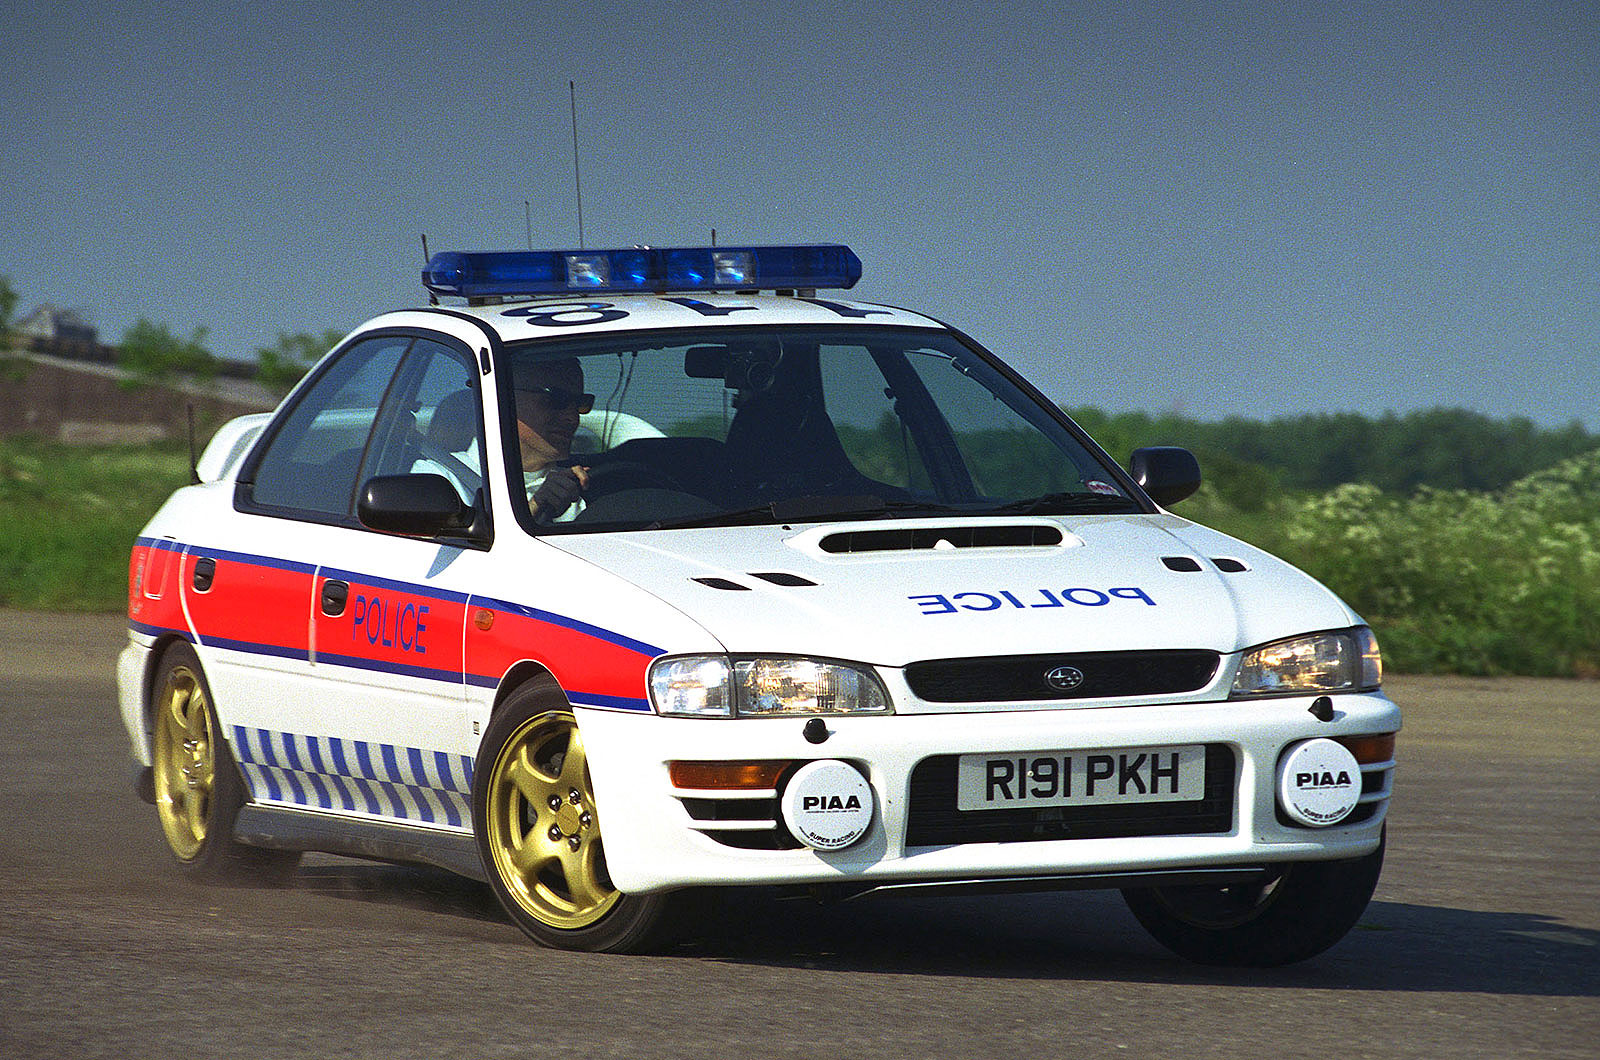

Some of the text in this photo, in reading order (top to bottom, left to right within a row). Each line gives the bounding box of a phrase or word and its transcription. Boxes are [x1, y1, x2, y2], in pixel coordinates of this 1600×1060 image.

[353, 594, 430, 654] POLICE
[985, 752, 1179, 801] R191 PKH
[1296, 771, 1352, 787] PIAA
[803, 795, 861, 810] PIAA
[809, 831, 855, 843] SUPER RACING
